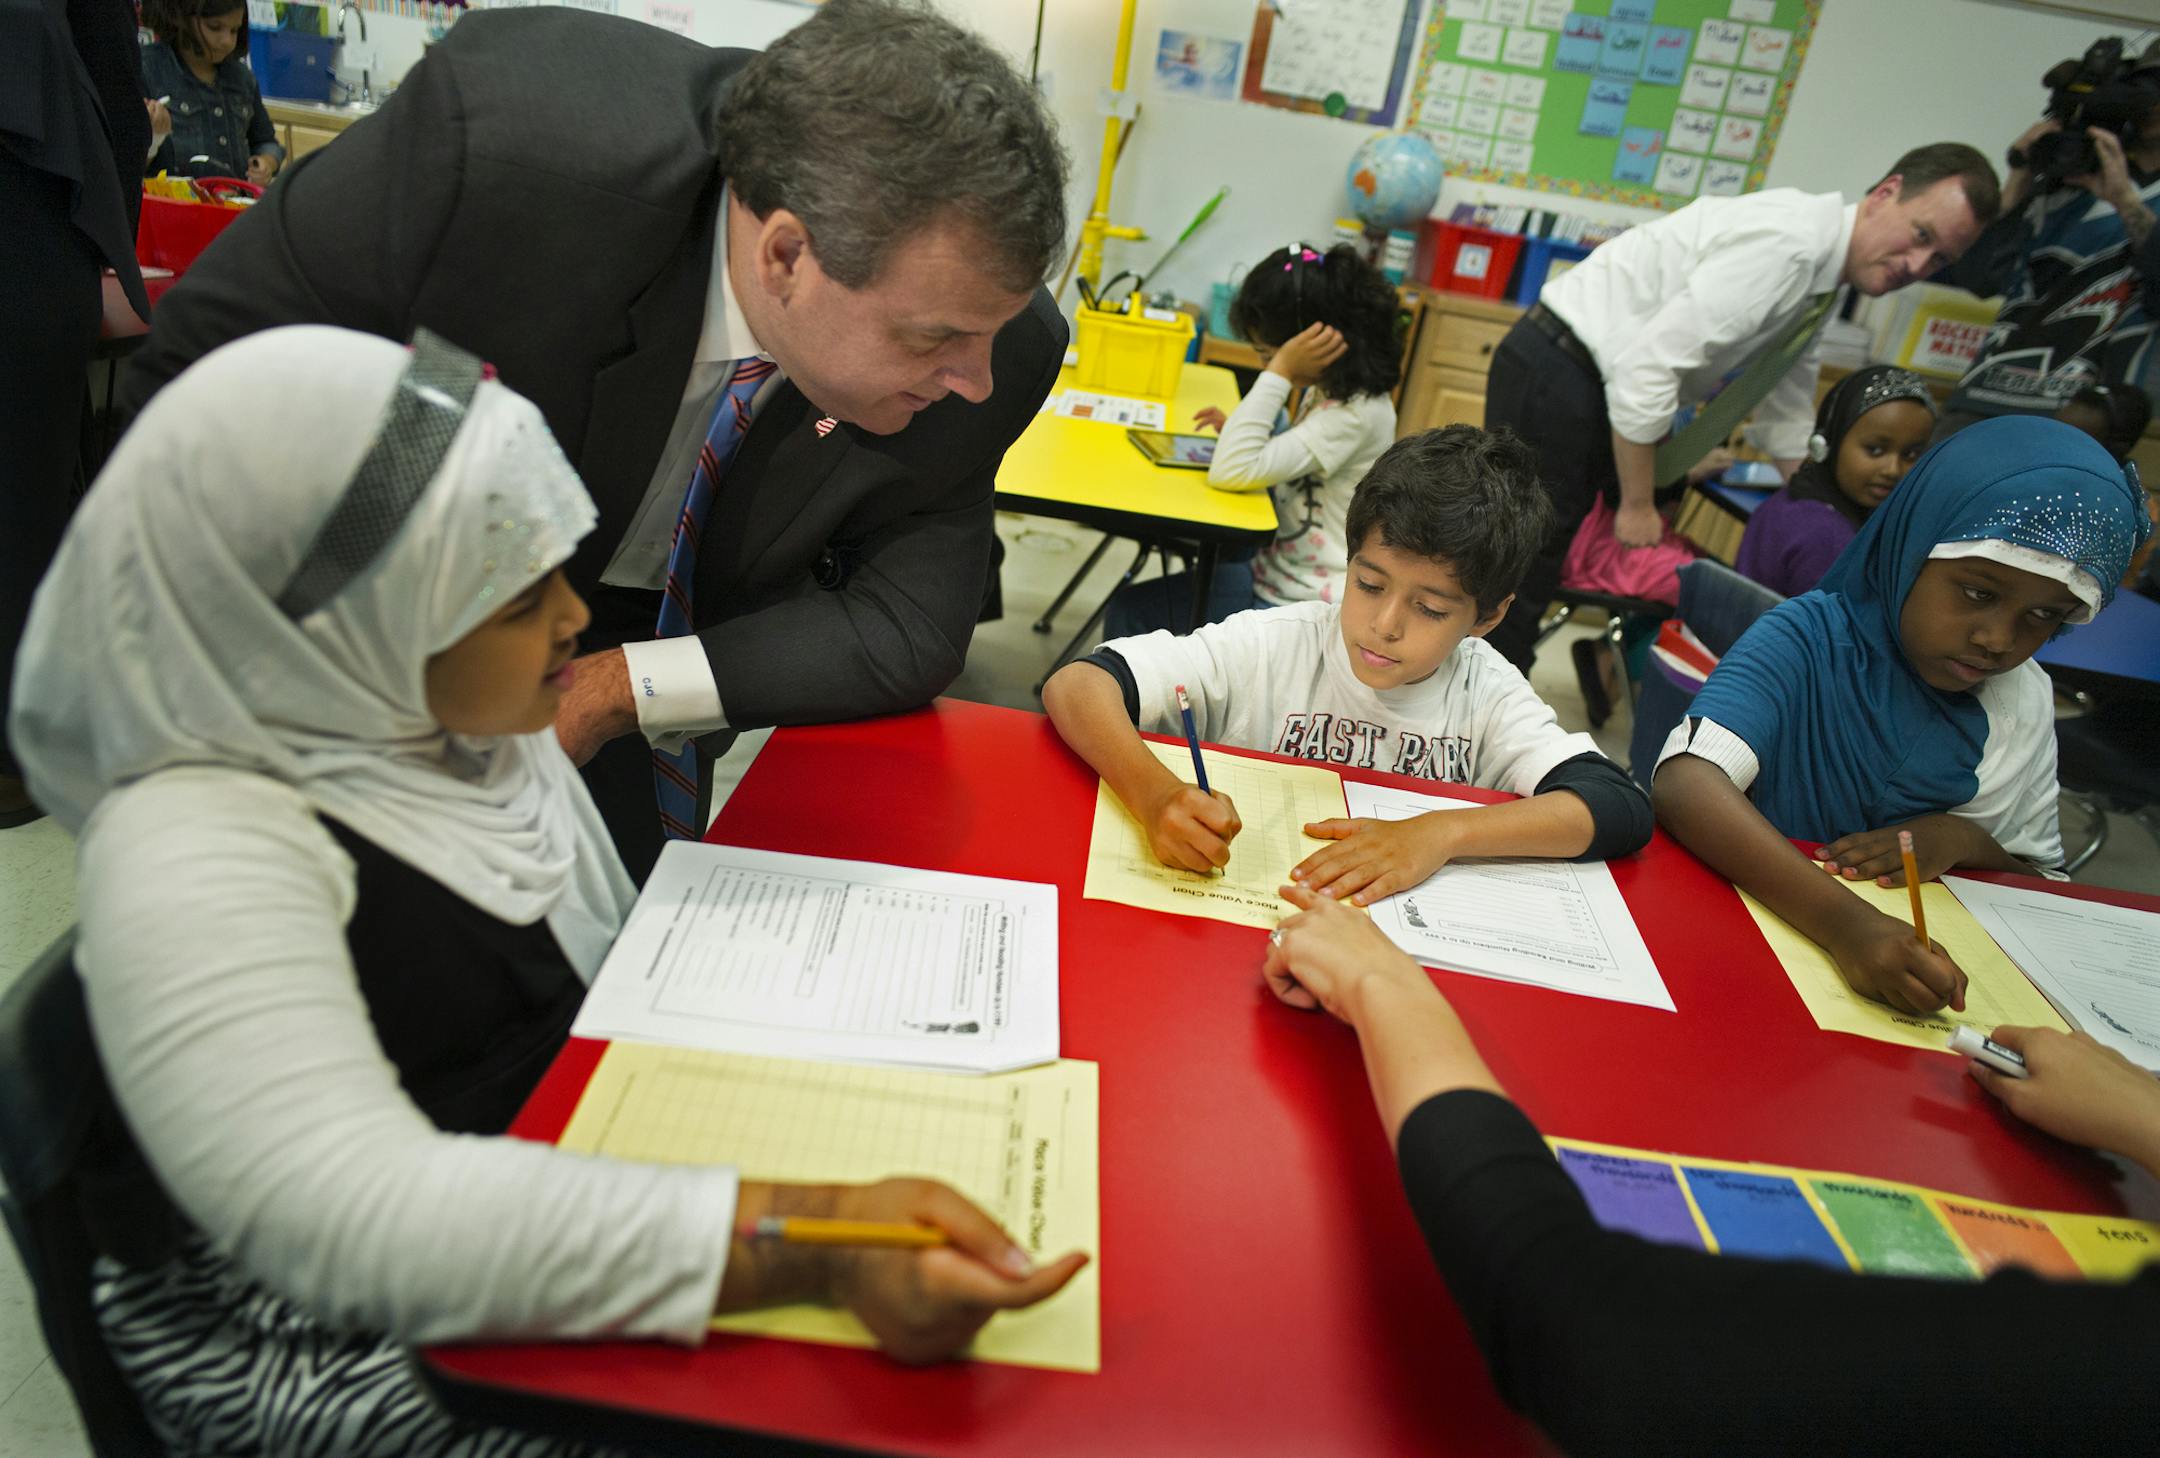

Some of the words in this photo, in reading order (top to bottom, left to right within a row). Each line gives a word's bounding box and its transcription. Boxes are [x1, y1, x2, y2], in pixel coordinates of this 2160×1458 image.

[1274, 713, 1387, 768] EAST
[1394, 731, 1472, 784] PARK
[1172, 885, 1206, 897] Chart
[1208, 891, 1242, 904] Value
[1246, 899, 1279, 911] Place
[1944, 1202, 2030, 1230] hundreds
[2096, 1226, 2150, 1244] tens
